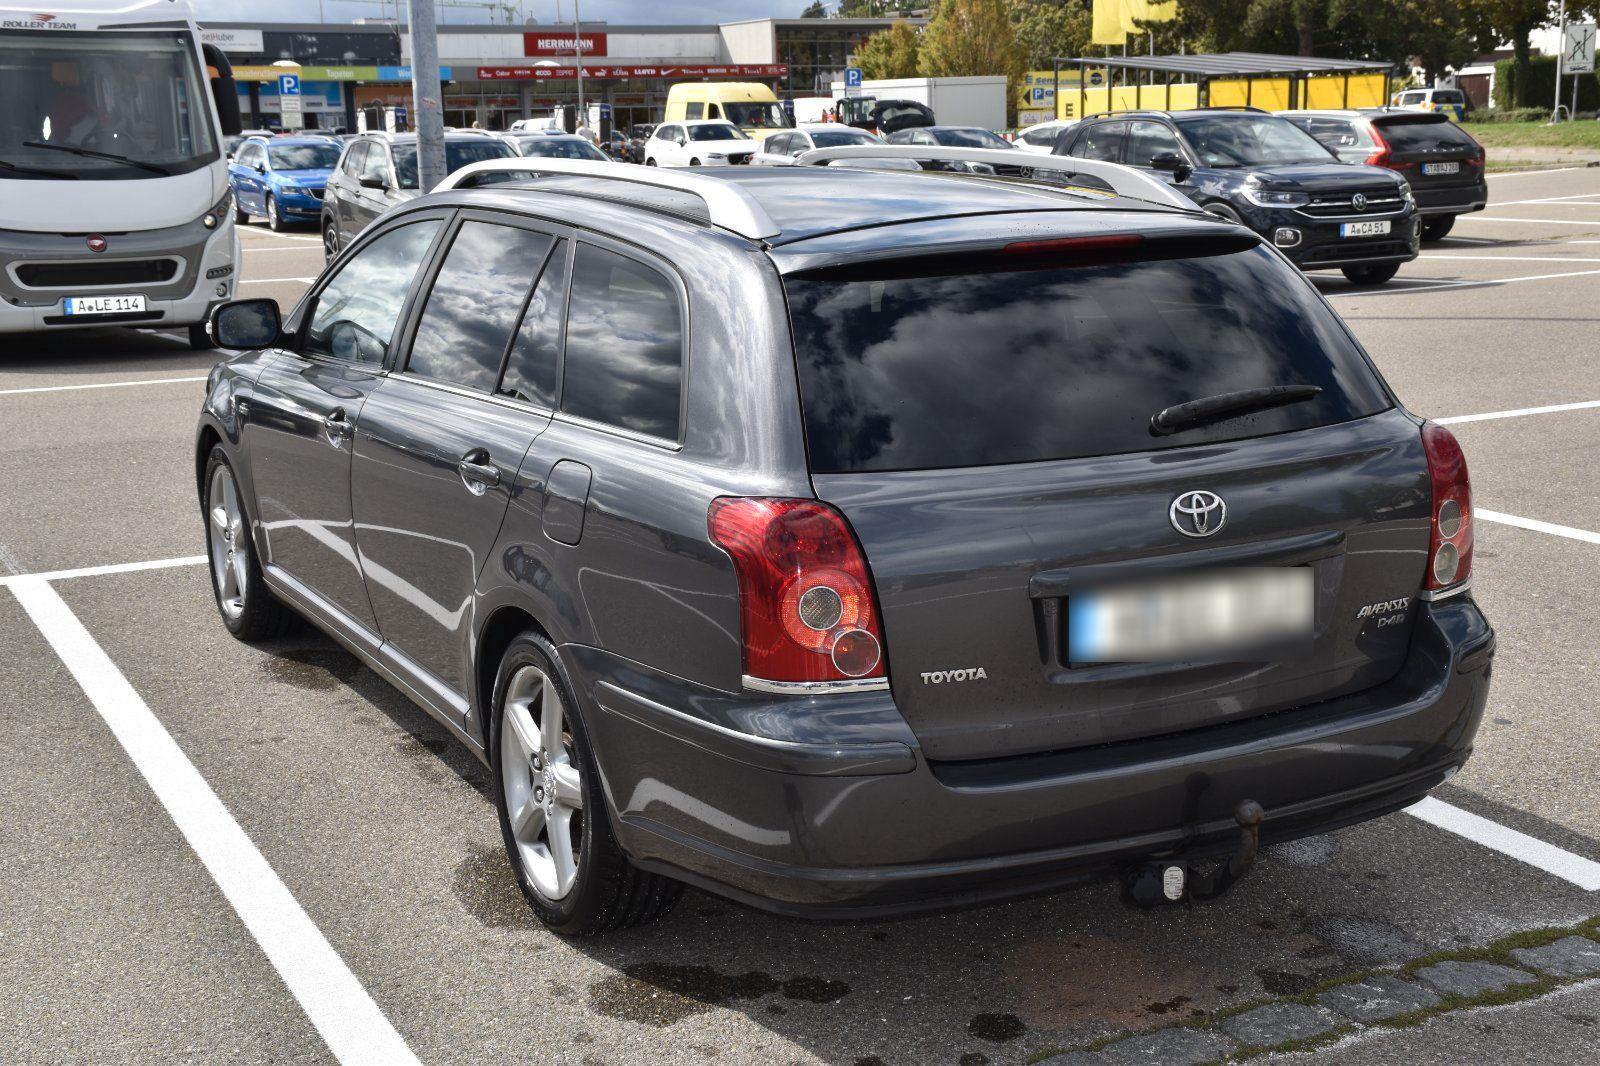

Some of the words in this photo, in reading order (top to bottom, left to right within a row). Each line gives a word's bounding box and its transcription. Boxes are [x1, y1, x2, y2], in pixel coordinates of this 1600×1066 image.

[3, 20, 45, 28] ROLLER
[48, 21, 76, 29] TEAM
[537, 39, 594, 49] HERRMANN
[634, 68, 656, 76] LLOYD
[849, 70, 859, 85] P
[283, 77, 295, 93] P
[95, 299, 112, 312] LE
[115, 298, 139, 311] 114
[1357, 597, 1409, 618] AVENSIS
[920, 667, 988, 685] TOYOTA
